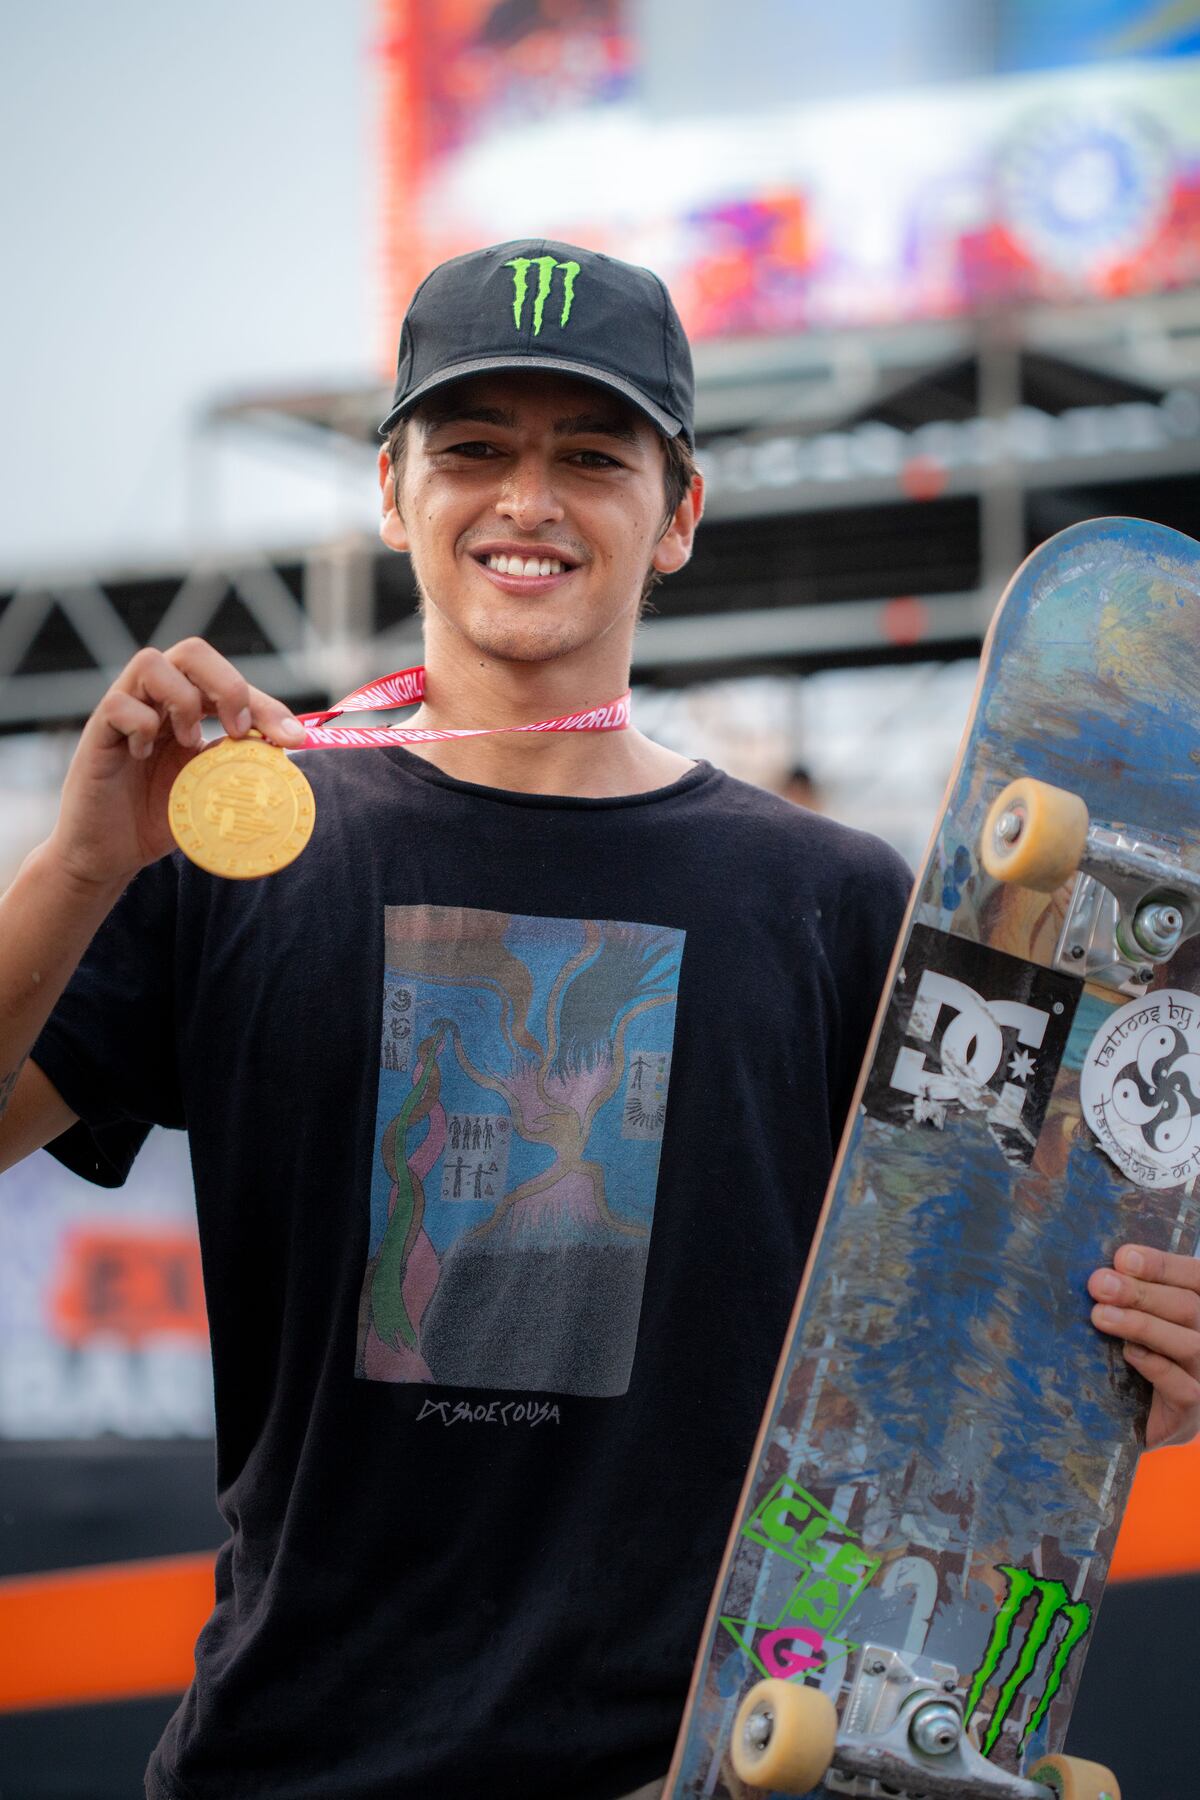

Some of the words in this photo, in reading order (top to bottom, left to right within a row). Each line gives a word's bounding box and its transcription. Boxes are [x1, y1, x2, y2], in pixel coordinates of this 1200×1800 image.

[559, 703, 626, 730] WORLD
[304, 727, 375, 745] WORL
[363, 728, 452, 745] URBAN
[1094, 1005, 1161, 1068] tattoos
[1168, 996, 1195, 1031] by
